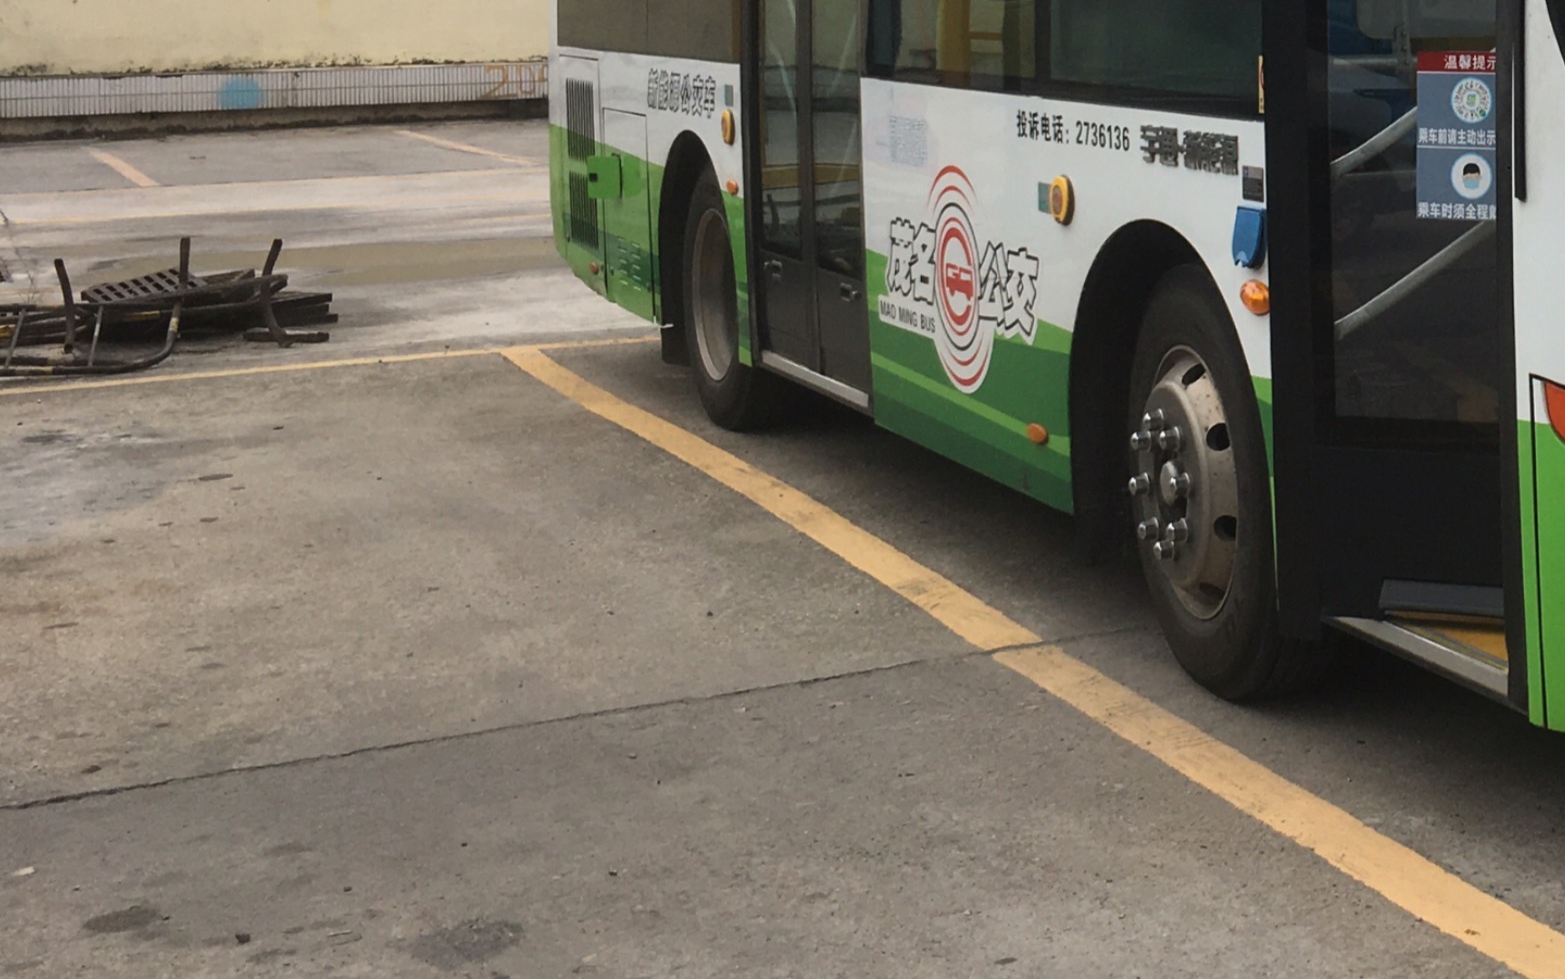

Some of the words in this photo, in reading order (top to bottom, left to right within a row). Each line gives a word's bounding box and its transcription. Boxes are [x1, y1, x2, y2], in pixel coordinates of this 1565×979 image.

[887, 217, 936, 306] 茂名
[978, 240, 1040, 337] 公交
[898, 306, 918, 328] MING
[920, 314, 936, 333] BUS
